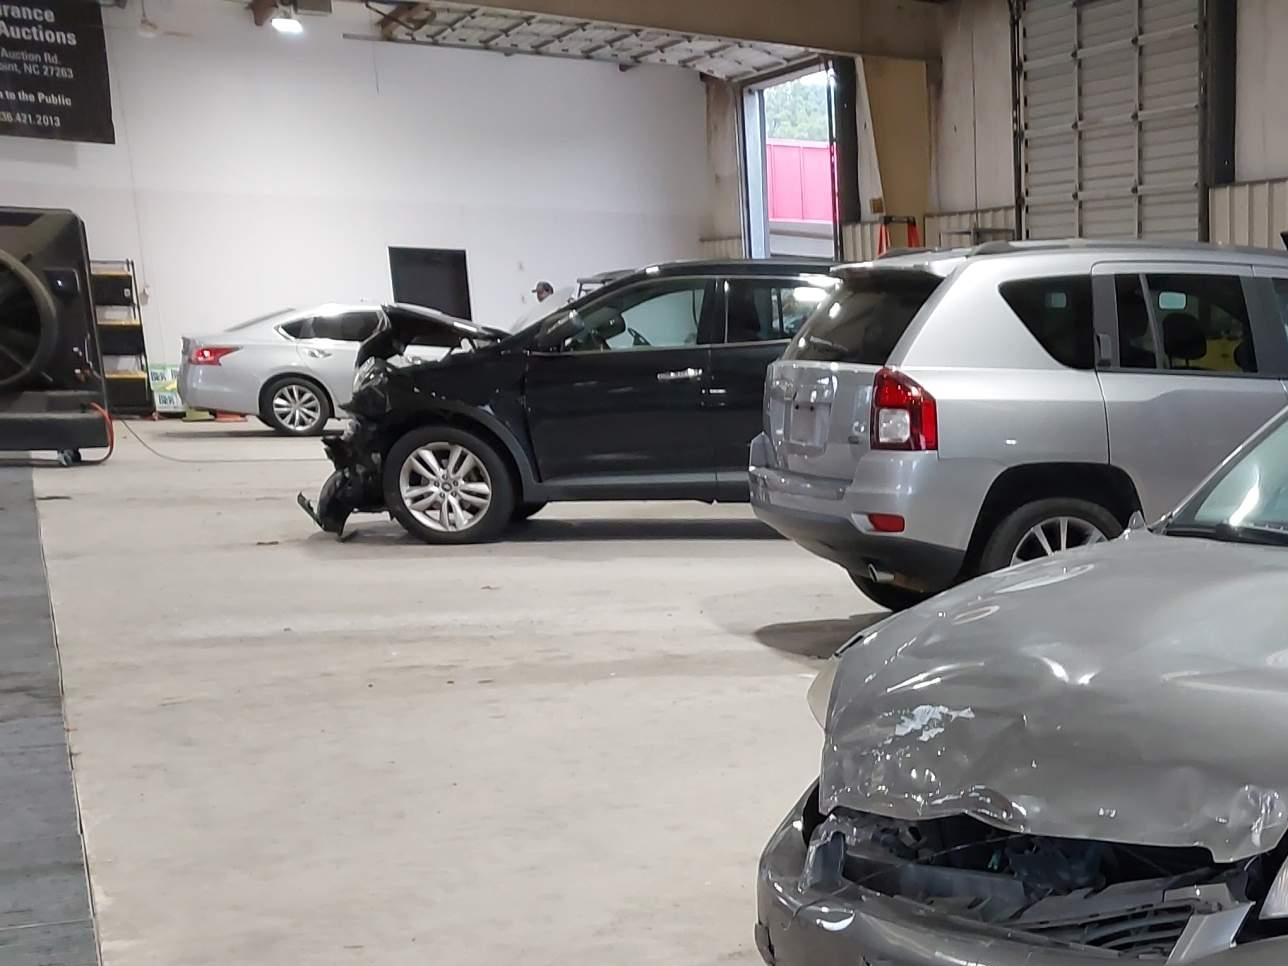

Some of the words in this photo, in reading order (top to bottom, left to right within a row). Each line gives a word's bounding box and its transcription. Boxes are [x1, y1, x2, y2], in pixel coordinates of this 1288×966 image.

[0, 20, 77, 46] Auctions
[0, 47, 42, 61] Auction
[23, 62, 40, 76] NC
[5, 90, 16, 100] to
[17, 89, 36, 102] the
[37, 91, 72, 107] Public
